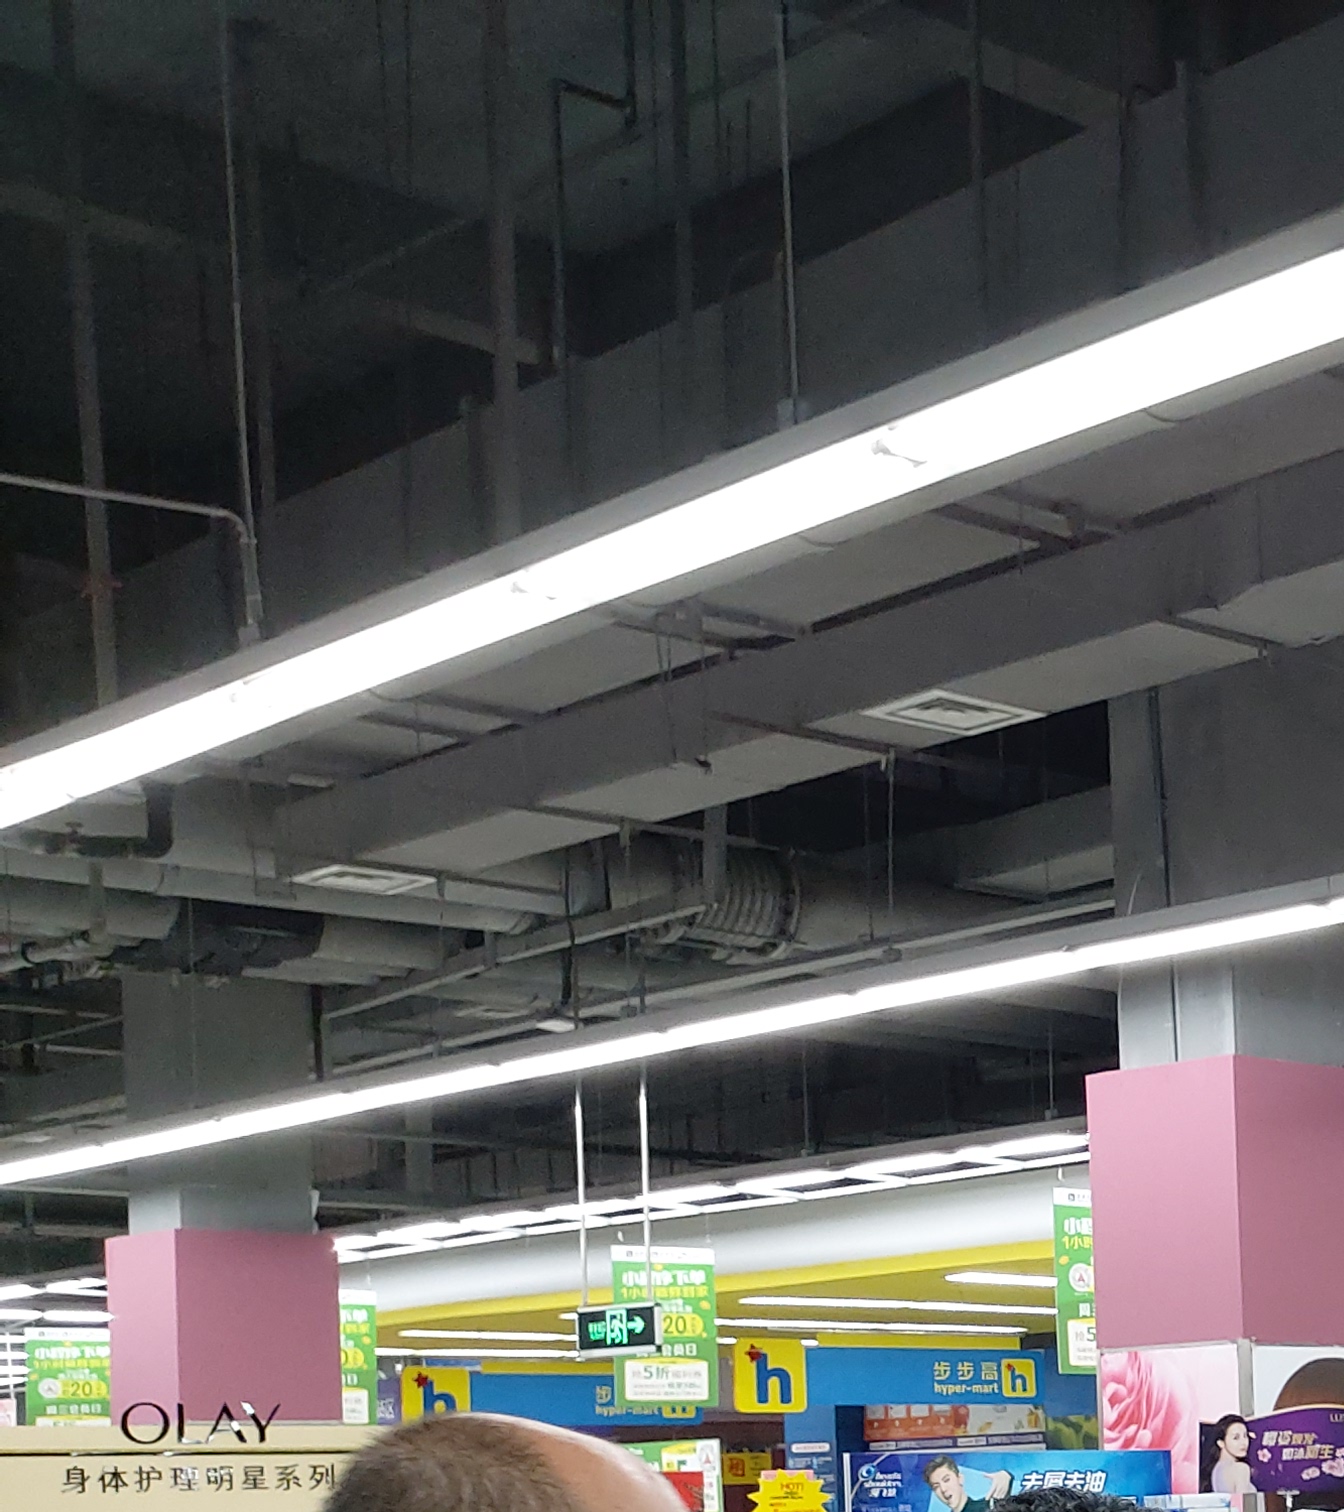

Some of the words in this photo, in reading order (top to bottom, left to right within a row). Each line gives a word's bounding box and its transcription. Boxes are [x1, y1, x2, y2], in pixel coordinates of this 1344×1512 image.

[933, 1360, 1000, 1381] 步步高
[933, 1382, 1000, 1397] hyper-mart
[119, 1400, 282, 1445] OLAY
[60, 1462, 337, 1494] 身体护理明星系列
[1020, 1470, 1107, 1493] 去屑去油
